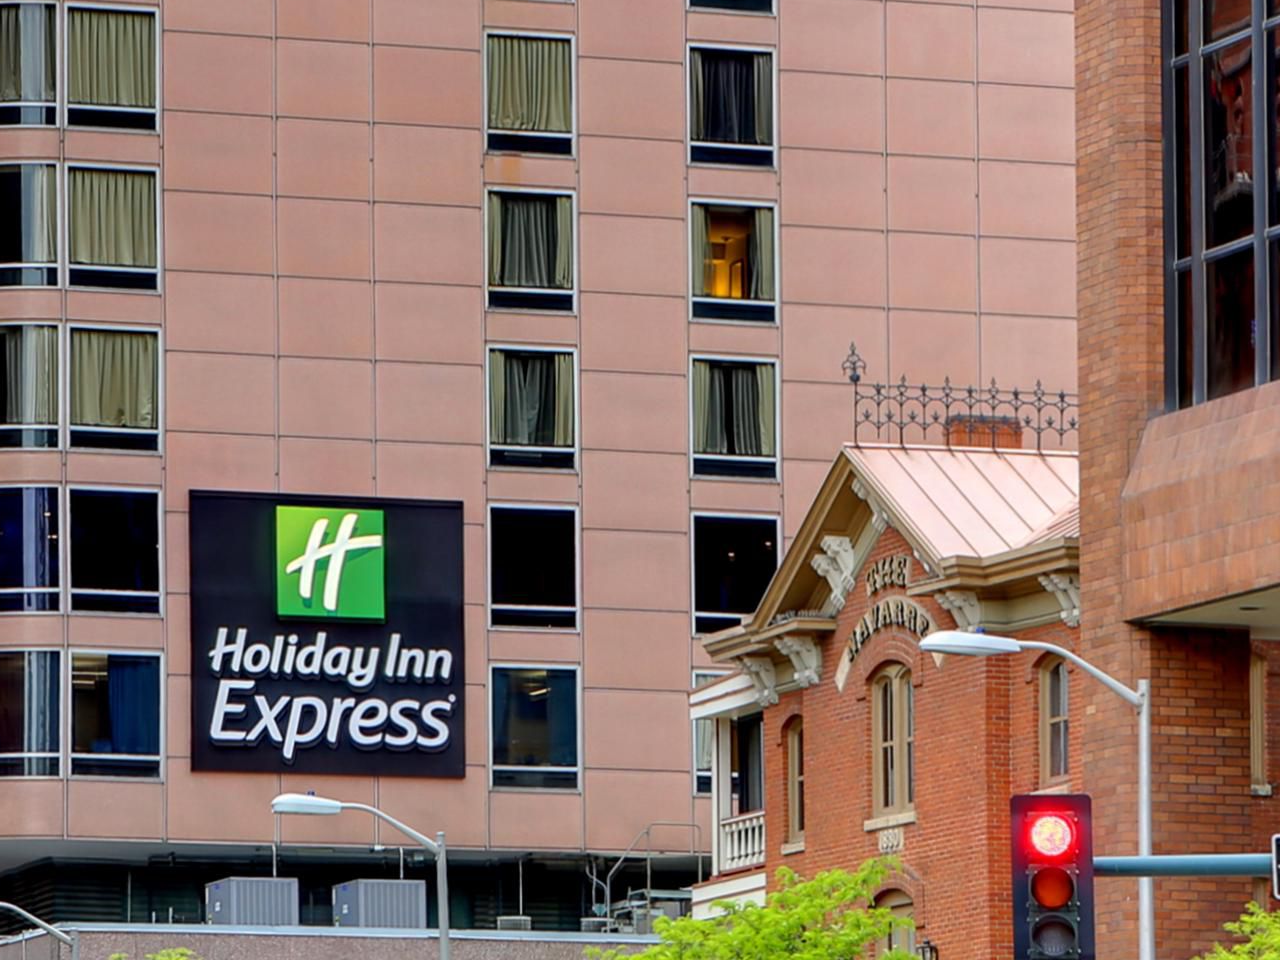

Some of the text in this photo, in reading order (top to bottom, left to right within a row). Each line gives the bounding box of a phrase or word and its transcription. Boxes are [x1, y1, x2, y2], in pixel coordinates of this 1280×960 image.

[866, 555, 908, 593] THE
[209, 627, 453, 687] Holiday Inn
[210, 680, 456, 759] Express
